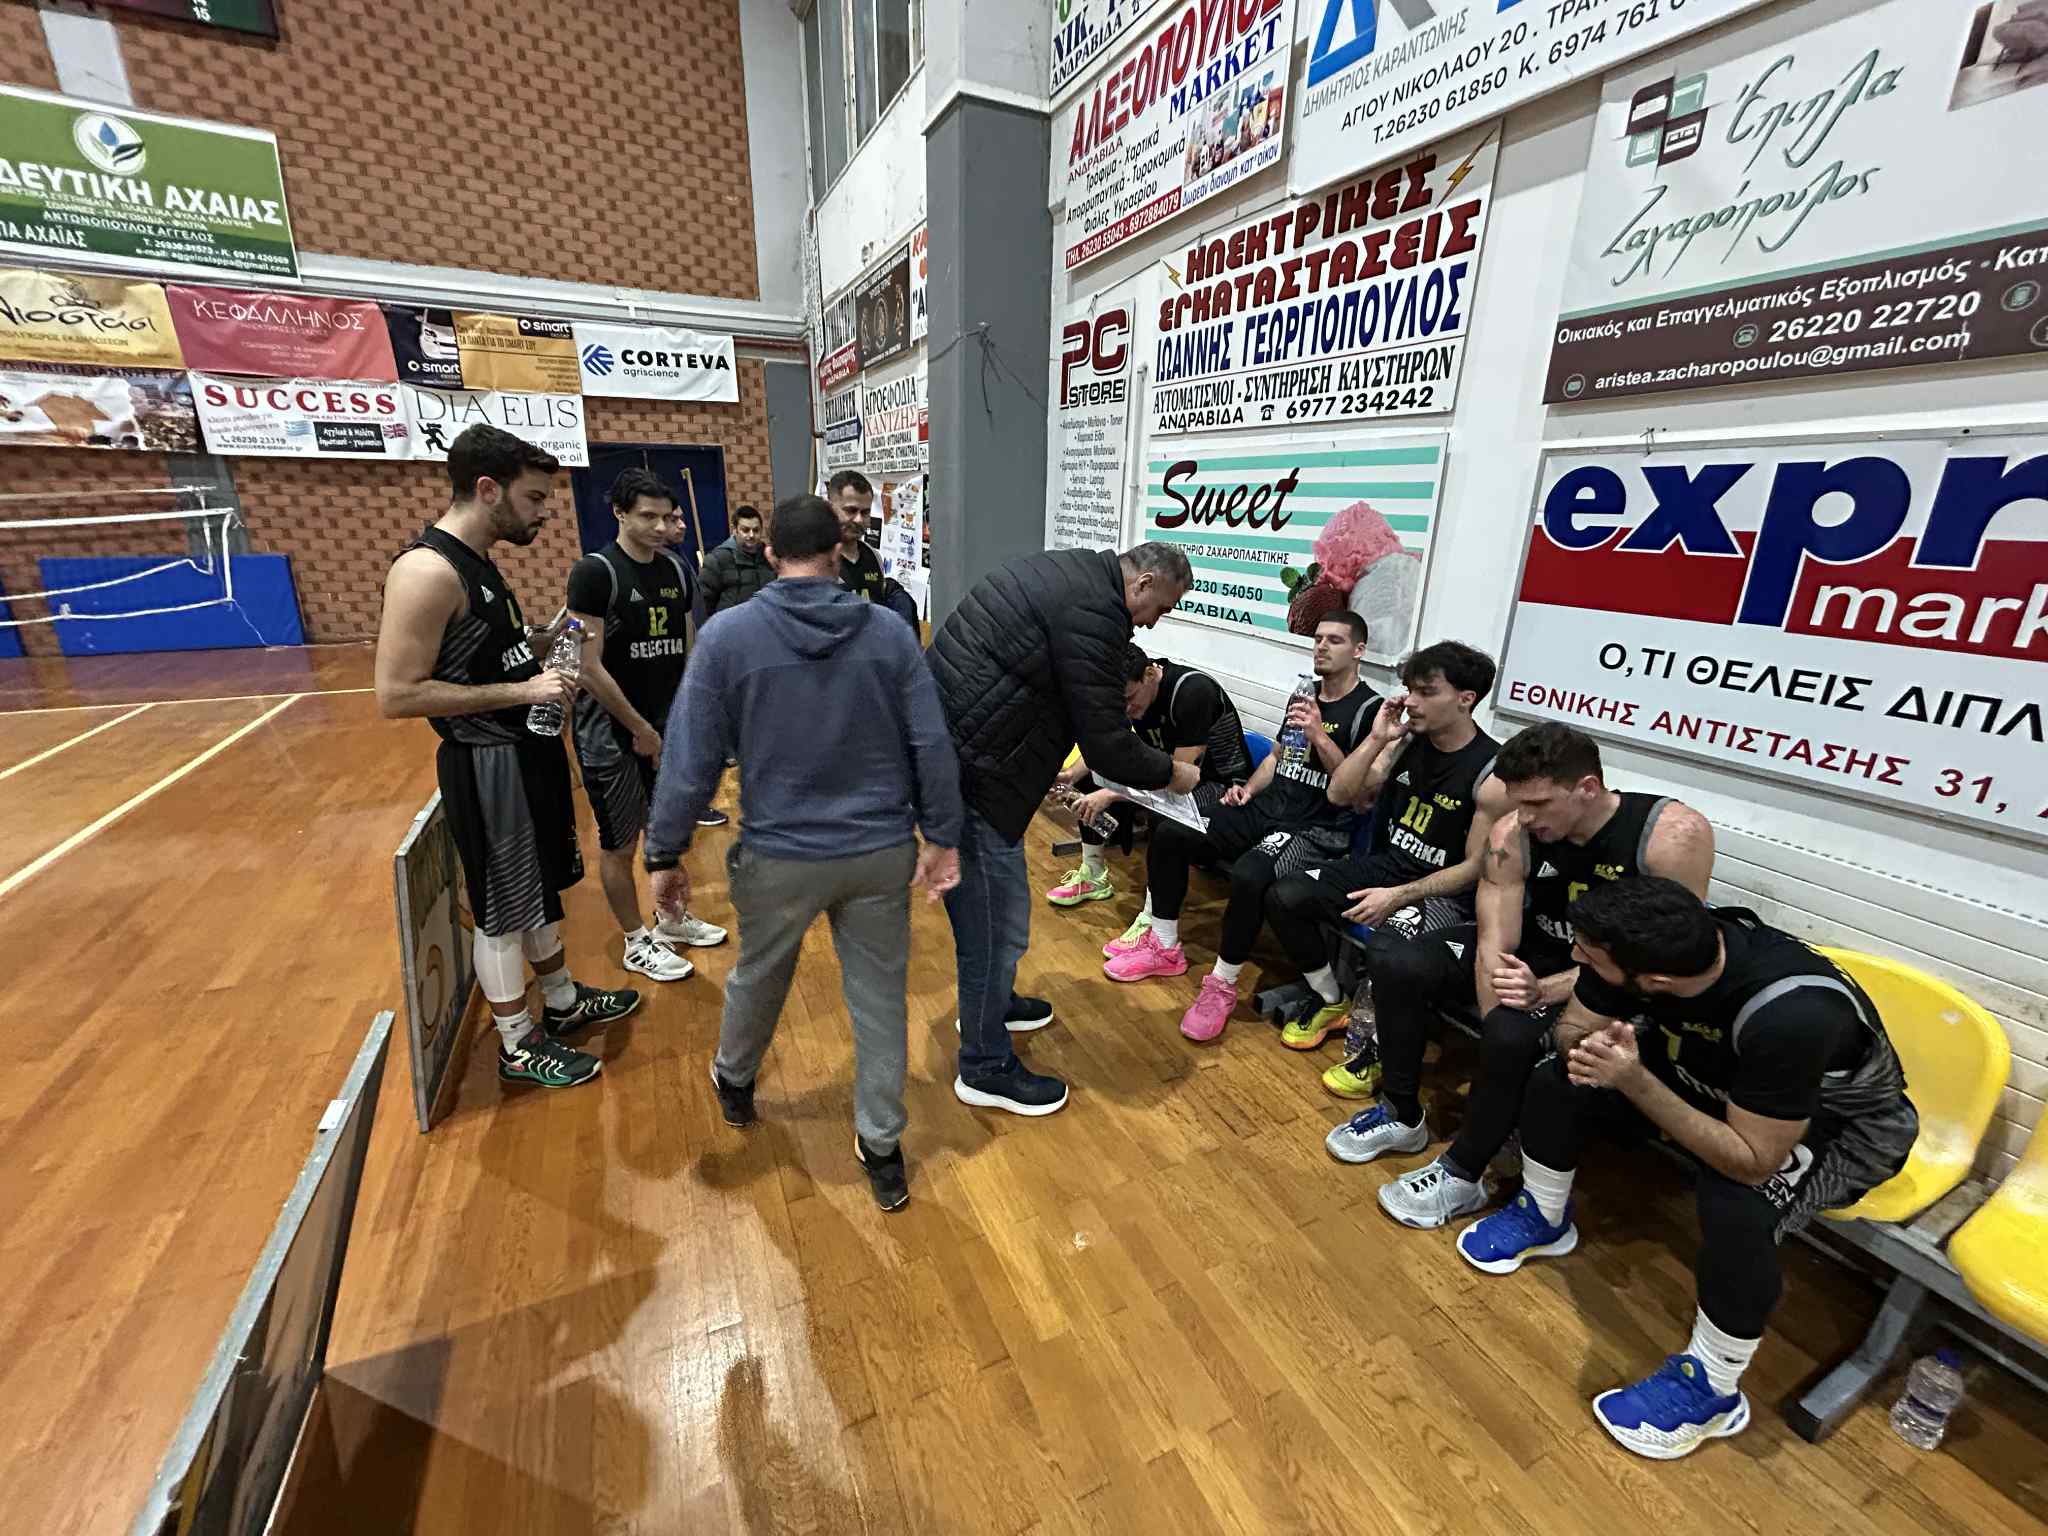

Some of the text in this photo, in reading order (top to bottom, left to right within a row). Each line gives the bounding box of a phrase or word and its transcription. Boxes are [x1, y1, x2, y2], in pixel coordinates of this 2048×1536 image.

[1051, 12, 1122, 91] ΑΝΔΡΑΒΙΔΑ
[1168, 13, 1281, 124] MARKET
[1302, 72, 1371, 118] ΔΗΜΗΤΡΙΟΣ
[1372, 8, 1469, 80] ΚΑΡΑΝΤΩΝΗΣ
[1069, 0, 1282, 167] ΑΛΕΞΟΠΟΥΛ
[1341, 96, 1389, 131] ΑΓΙΟΥ
[1393, 38, 1496, 110] ΝΙΚΟΛΑΟΥ
[1373, 97, 1442, 144] Τ.26230
[1445, 67, 1508, 112] 61850
[1549, 20, 1606, 64] 6974
[1616, 3, 1658, 36] 761
[1068, 135, 1124, 185] ΑΝΔΡΑΒΙΔΑ
[165, 185, 284, 226] ΑΧΑΙΑΣ
[1081, 236, 1101, 258] 26230
[1102, 222, 1124, 249] 55043
[1129, 191, 1180, 233] 6972884079
[1186, 153, 1438, 285] ΗΛΕΚΤΡΙΚΕΣ
[24, 223, 88, 248] ΑΧΑΪΑΣ
[157, 228, 216, 243] ΑΓΓΕΛΟΣ
[1158, 199, 1482, 332] ΕΓΚΑΤΑΣΤΑΣΕΙΣ
[193, 299, 366, 331] ΚΕΦΑΛΛΗΝΟΣ
[1155, 261, 1469, 383] ΙΩΑΝΝΗΣ ΓΕΩΡΓΙΟΠΟΥΛΟΣ
[1558, 319, 1623, 346] Οικιακός
[1626, 315, 1652, 333] και
[1655, 285, 1815, 328] Επαγγελματικός
[1819, 258, 1971, 301] Εξοπλισμός
[1768, 289, 1981, 344] 26220 22720
[532, 321, 570, 334] smart
[422, 361, 460, 374] smart
[622, 349, 730, 371] CORTEVA
[623, 367, 680, 379] agriscience
[1059, 308, 1130, 409] PC
[1595, 328, 1971, 391] aristea.zacharopoulou@gmail.com
[204, 385, 396, 415] SUCCESS
[1068, 379, 1125, 407] STORE
[1153, 345, 1456, 414] ΑΥΤΟΜΑΤΙΣΜΟΙ ΣΥΝΤΗΡΗΣΗ ΚΑΥΣΤΗΡΩΝ
[416, 389, 578, 428] DIA ELIS
[1158, 386, 1433, 430] ΑΝΔΡΑΒΙΔΑ 6977 234242
[540, 439, 582, 450] organic
[569, 452, 583, 463] oil
[1155, 459, 1300, 532] Sweet
[1206, 545, 1290, 565] ΖΑΧΑΡΟΠΛΑΣΤΙΚΗΣ
[1190, 578, 1263, 602] 230 54050
[648, 606, 668, 636] 12
[1173, 599, 1253, 625] ΔΡΑΒΙΔΑ
[501, 640, 534, 672] SELE
[630, 638, 683, 659] SELECTIA
[1599, 642, 1675, 680] Ο,ΤΙ
[1686, 655, 1874, 711] ΘΕΛΕΙΣ
[1509, 681, 1640, 726] ΕΘΝΙΚΗΣ
[1649, 710, 1911, 786] ΑΝΤΙΣΤΑΣΗΣ
[1399, 796, 1434, 835] 10
[1389, 827, 1446, 867] ECTIKA
